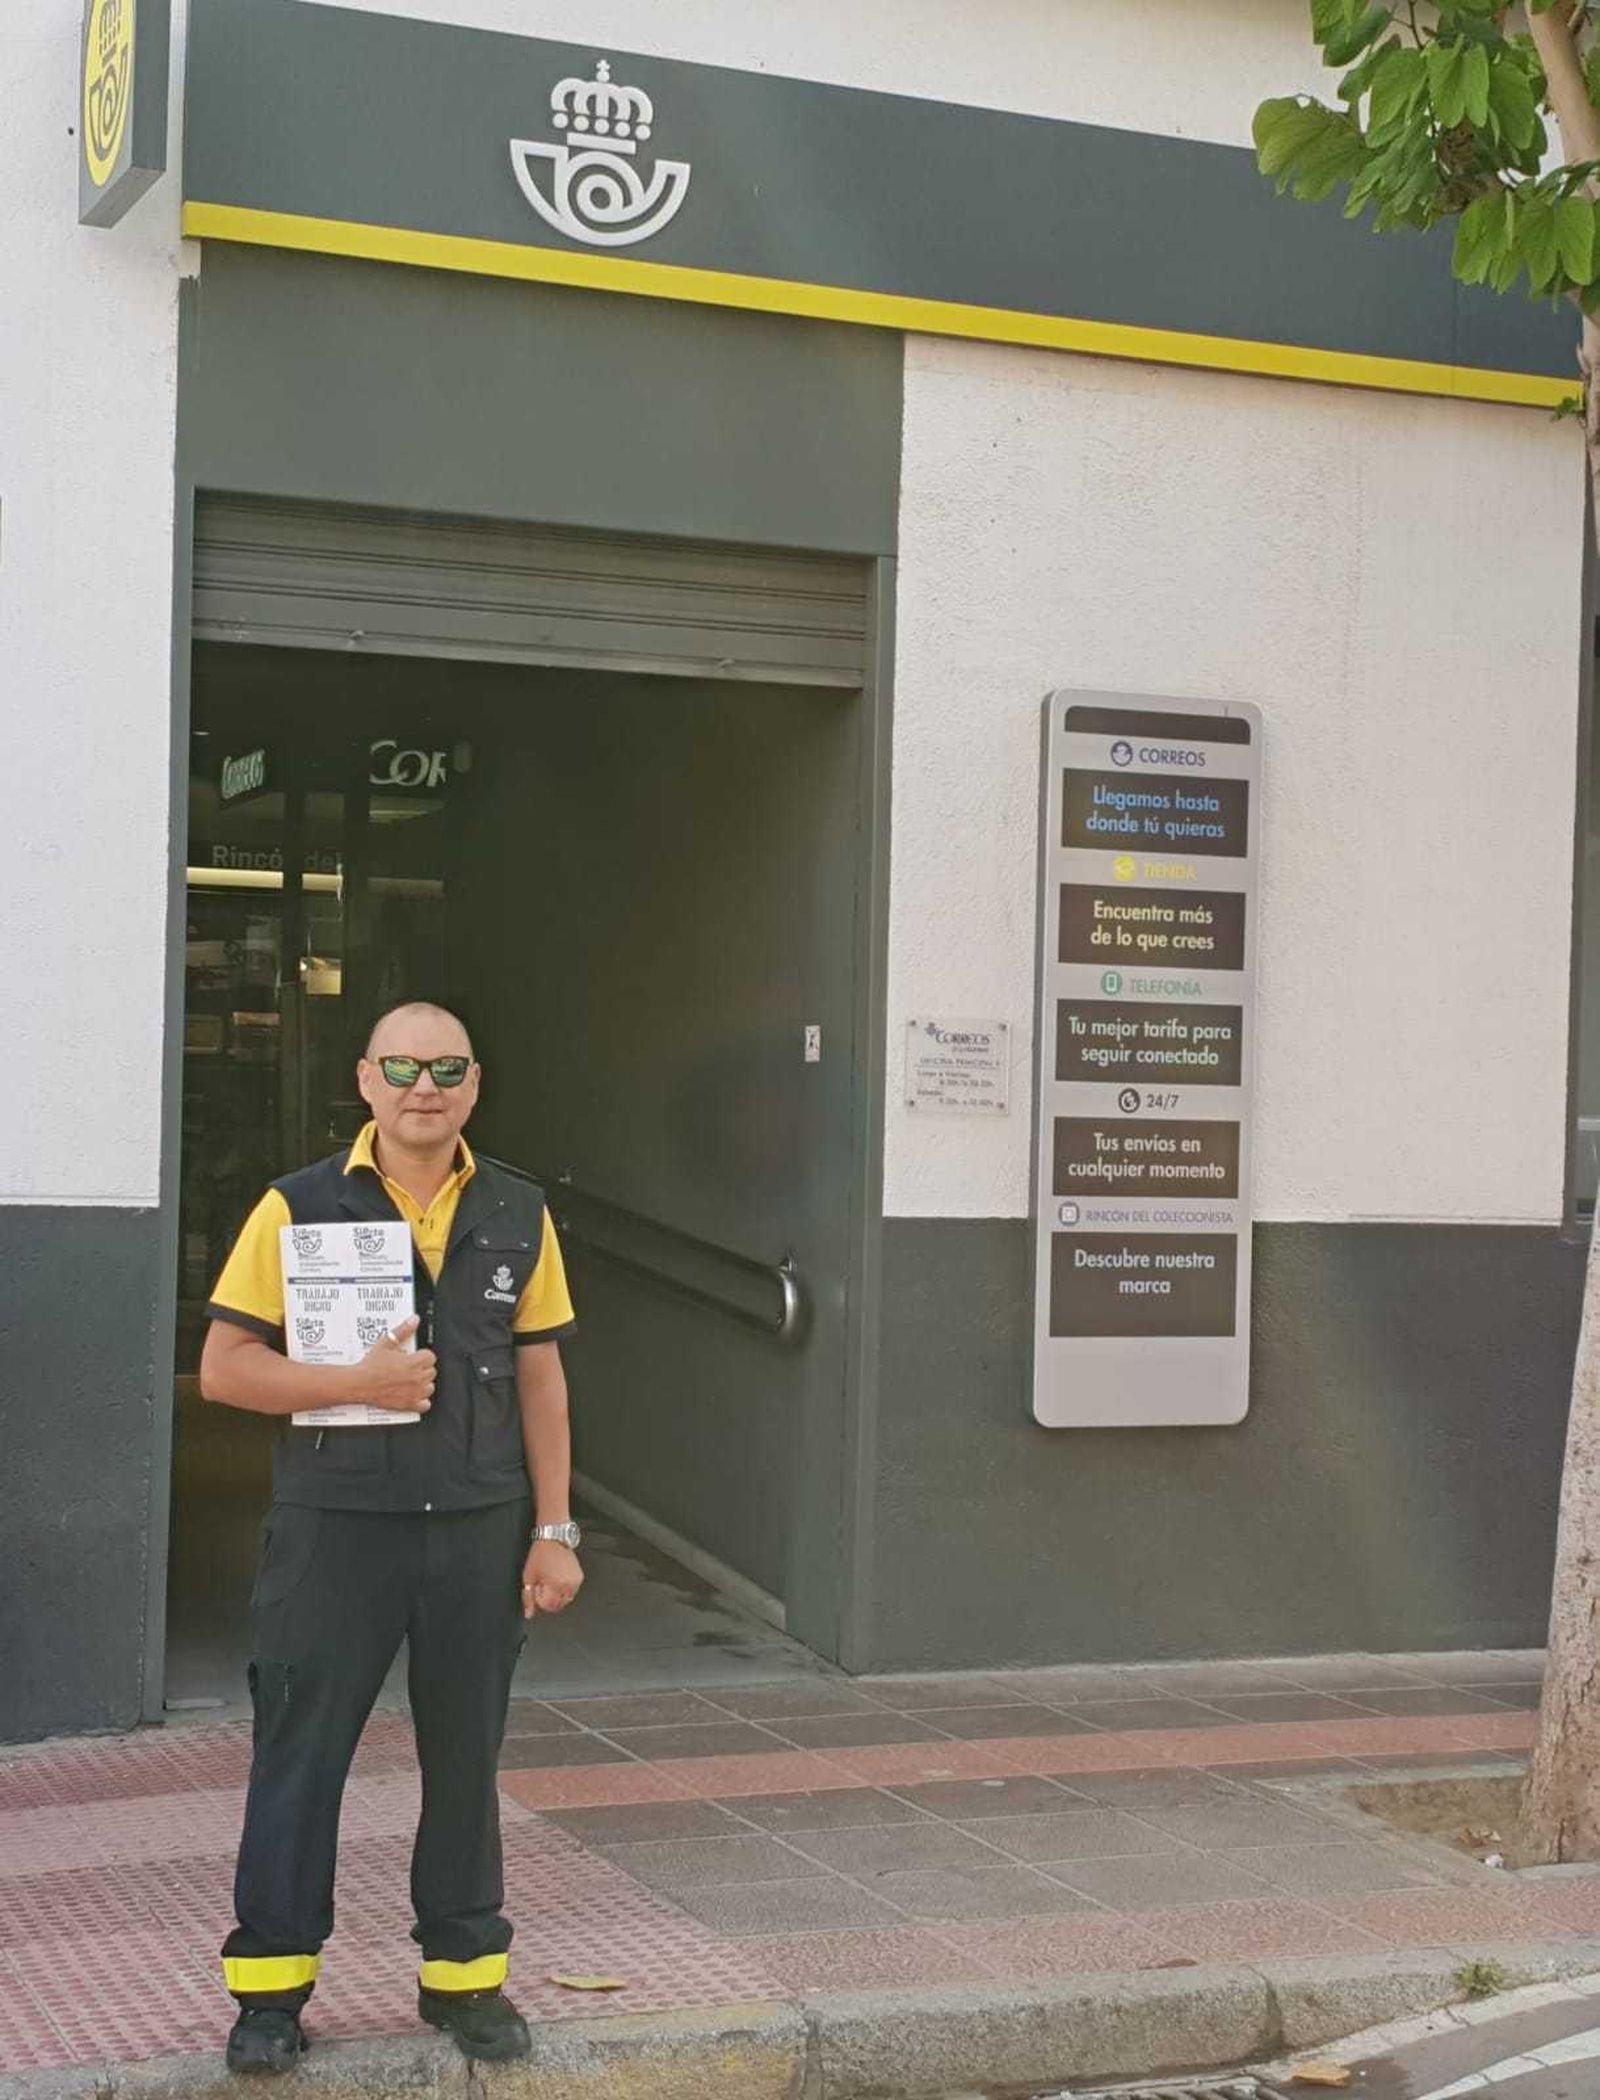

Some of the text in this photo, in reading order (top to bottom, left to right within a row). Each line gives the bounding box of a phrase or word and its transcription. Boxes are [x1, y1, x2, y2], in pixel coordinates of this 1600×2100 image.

[1139, 748, 1206, 767] CORREOS
[1093, 785, 1220, 812] Llegamos hasta
[1086, 812, 1225, 840] donde tú quieras
[1093, 900, 1213, 925] Encuentra más
[1091, 925, 1215, 952] de lo que crees
[1130, 978, 1202, 995] TELEFONÍA
[1069, 1015, 1232, 1044] Tu mejor tarifa para
[1081, 1044, 1219, 1067] seguir conectado
[1146, 1094, 1180, 1111] 24/7
[1093, 1132, 1119, 1151] Tus
[1181, 1137, 1202, 1153] en
[1068, 1157, 1225, 1182] cualquier momento
[1131, 1210, 1150, 1223] DEL
[1074, 1249, 1216, 1269] Descubre nuestra
[1118, 1278, 1172, 1295] marca
